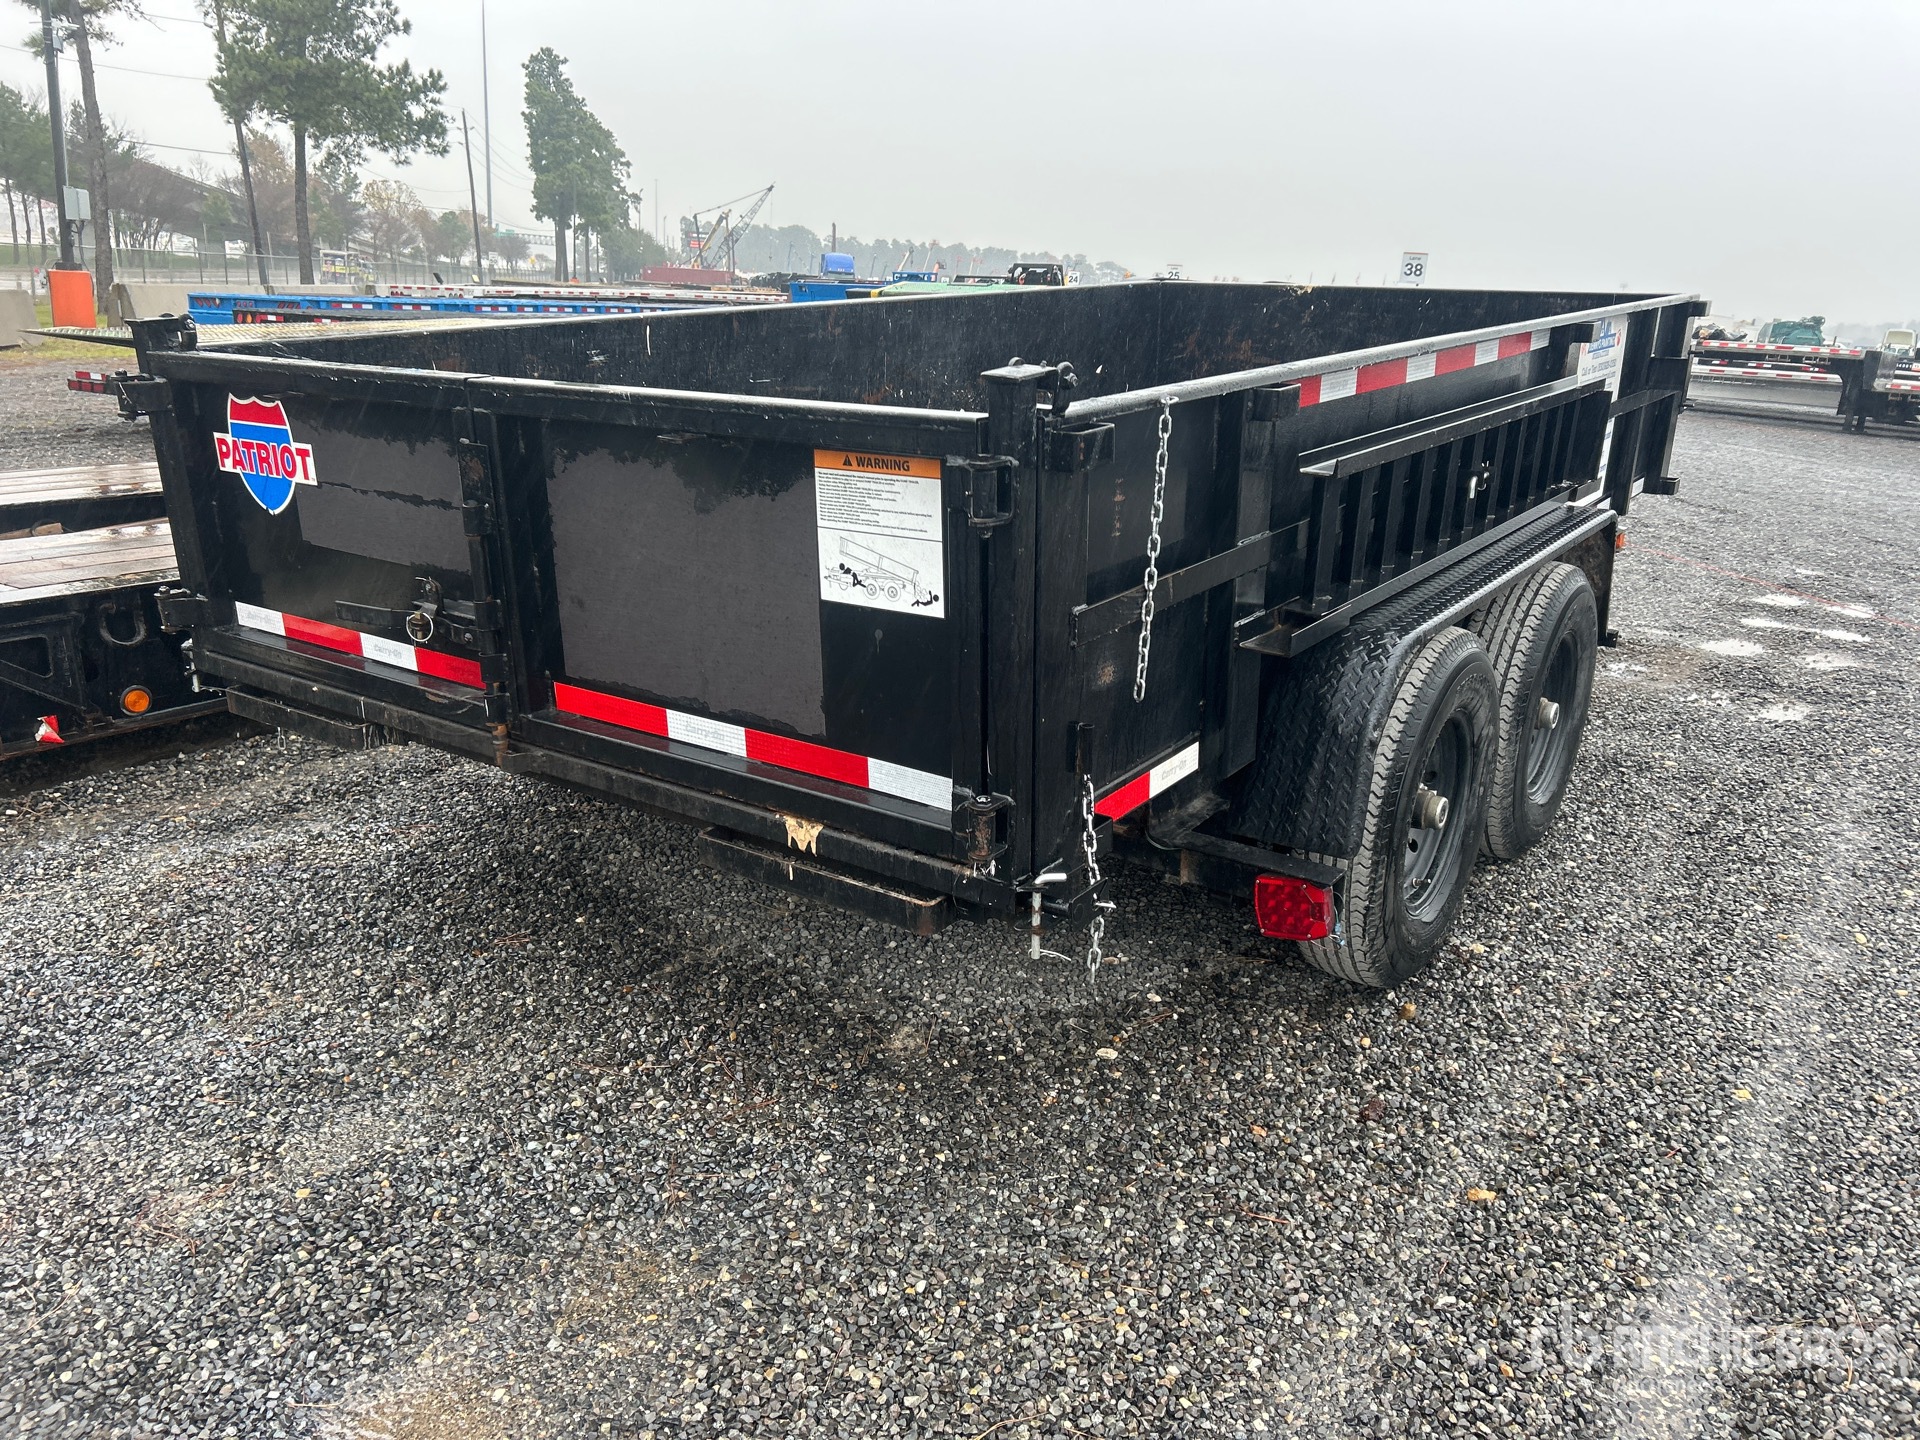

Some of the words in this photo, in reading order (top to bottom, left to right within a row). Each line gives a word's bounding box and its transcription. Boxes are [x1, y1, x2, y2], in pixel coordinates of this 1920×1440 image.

[1168, 271, 1180, 280] 25
[1404, 263, 1423, 277] 38
[1069, 275, 1078, 283] 24
[216, 438, 310, 480] PATRIOT
[855, 456, 910, 471] WARNING
